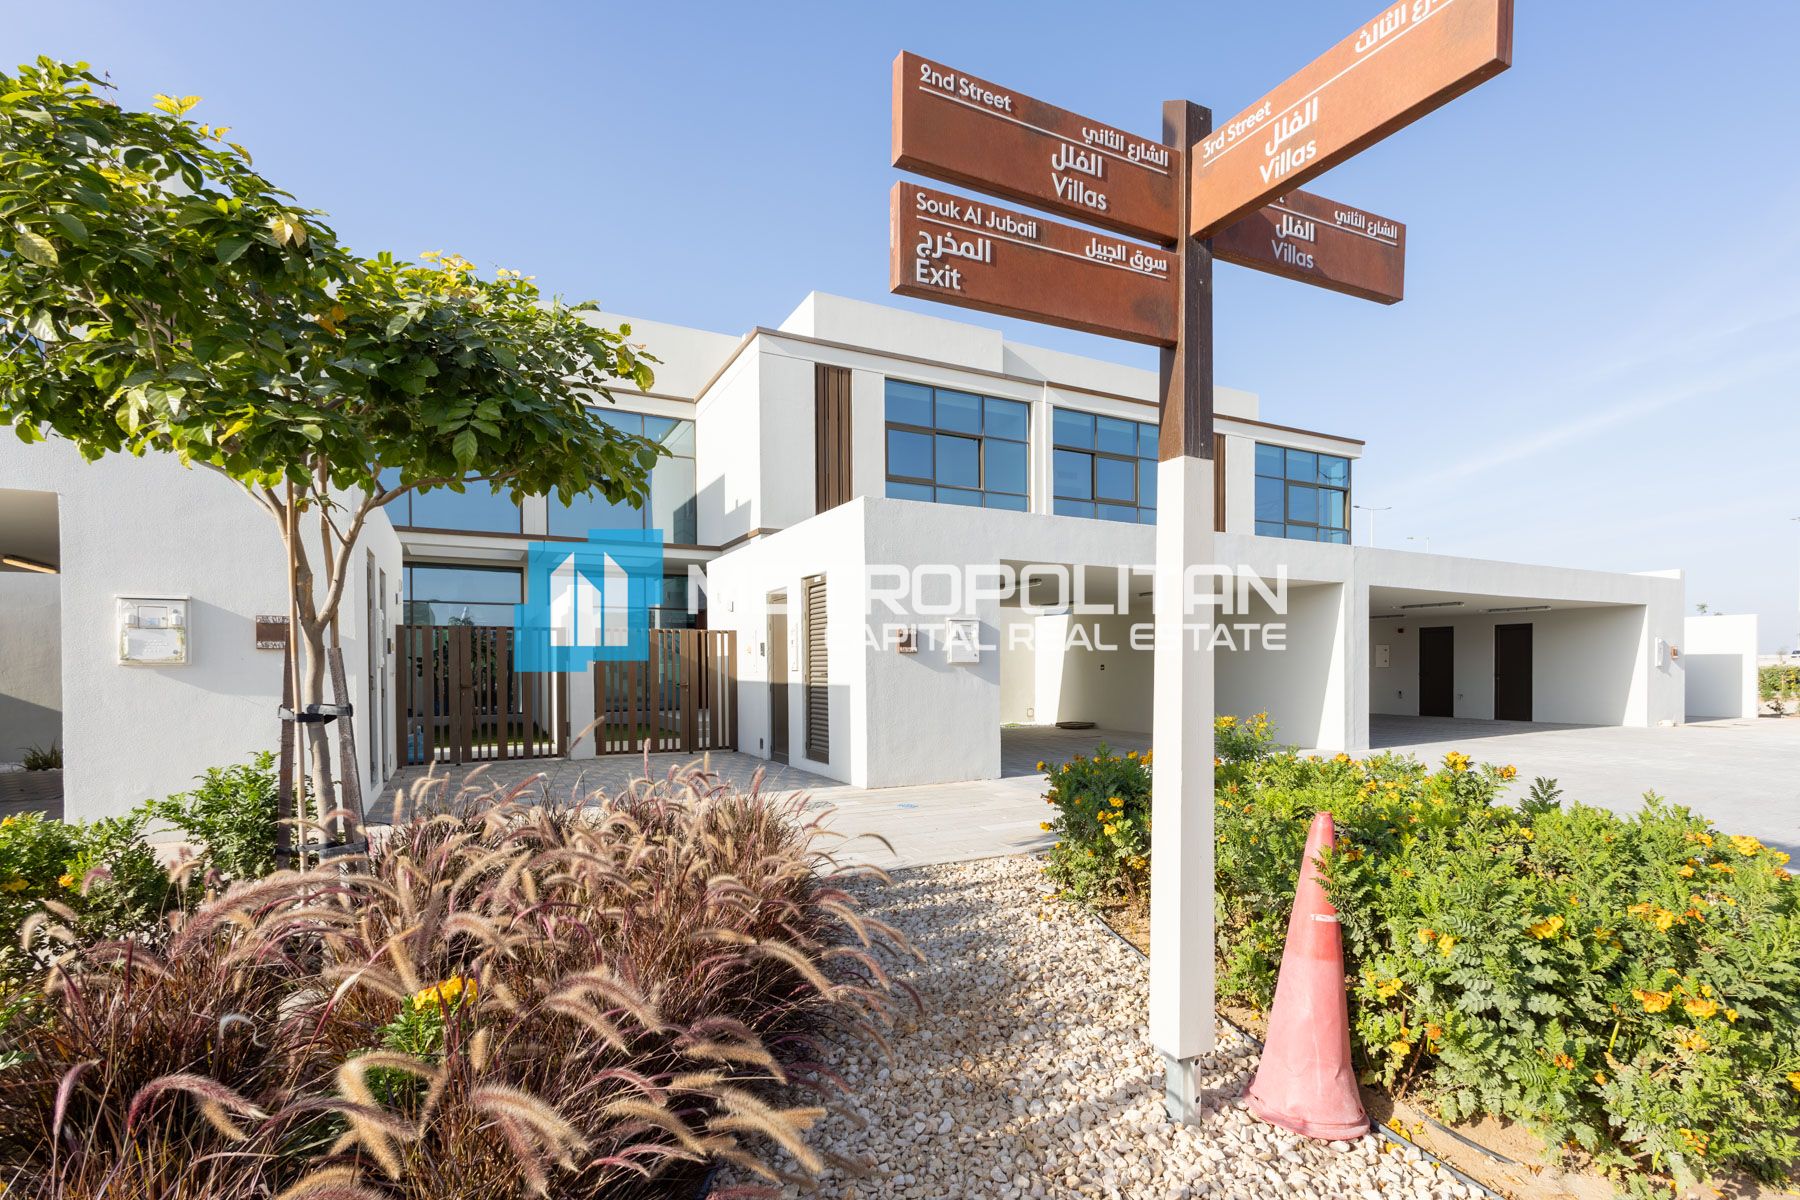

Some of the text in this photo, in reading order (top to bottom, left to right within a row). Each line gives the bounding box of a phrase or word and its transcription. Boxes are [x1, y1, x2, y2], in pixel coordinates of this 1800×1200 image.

[1354, 4, 1407, 53] الثالث
[920, 64, 1012, 112] 2nd Street
[1203, 100, 1272, 159] 3rd Street
[1265, 97, 1319, 156] الفلل
[1052, 144, 1103, 178] الفلل
[1082, 127, 1169, 167] الشارع الثاني
[1259, 140, 1317, 184] Villas
[1051, 173, 1107, 211] Villas
[916, 192, 1037, 239] Souk Al Jubail
[1275, 214, 1315, 242] الفلل
[1335, 210, 1397, 240] الشارع الثاني
[916, 231, 991, 263] المخرج
[1085, 238, 1167, 272] سوق الجبيل
[1271, 240, 1314, 269] Villas
[916, 259, 961, 290] Exit
